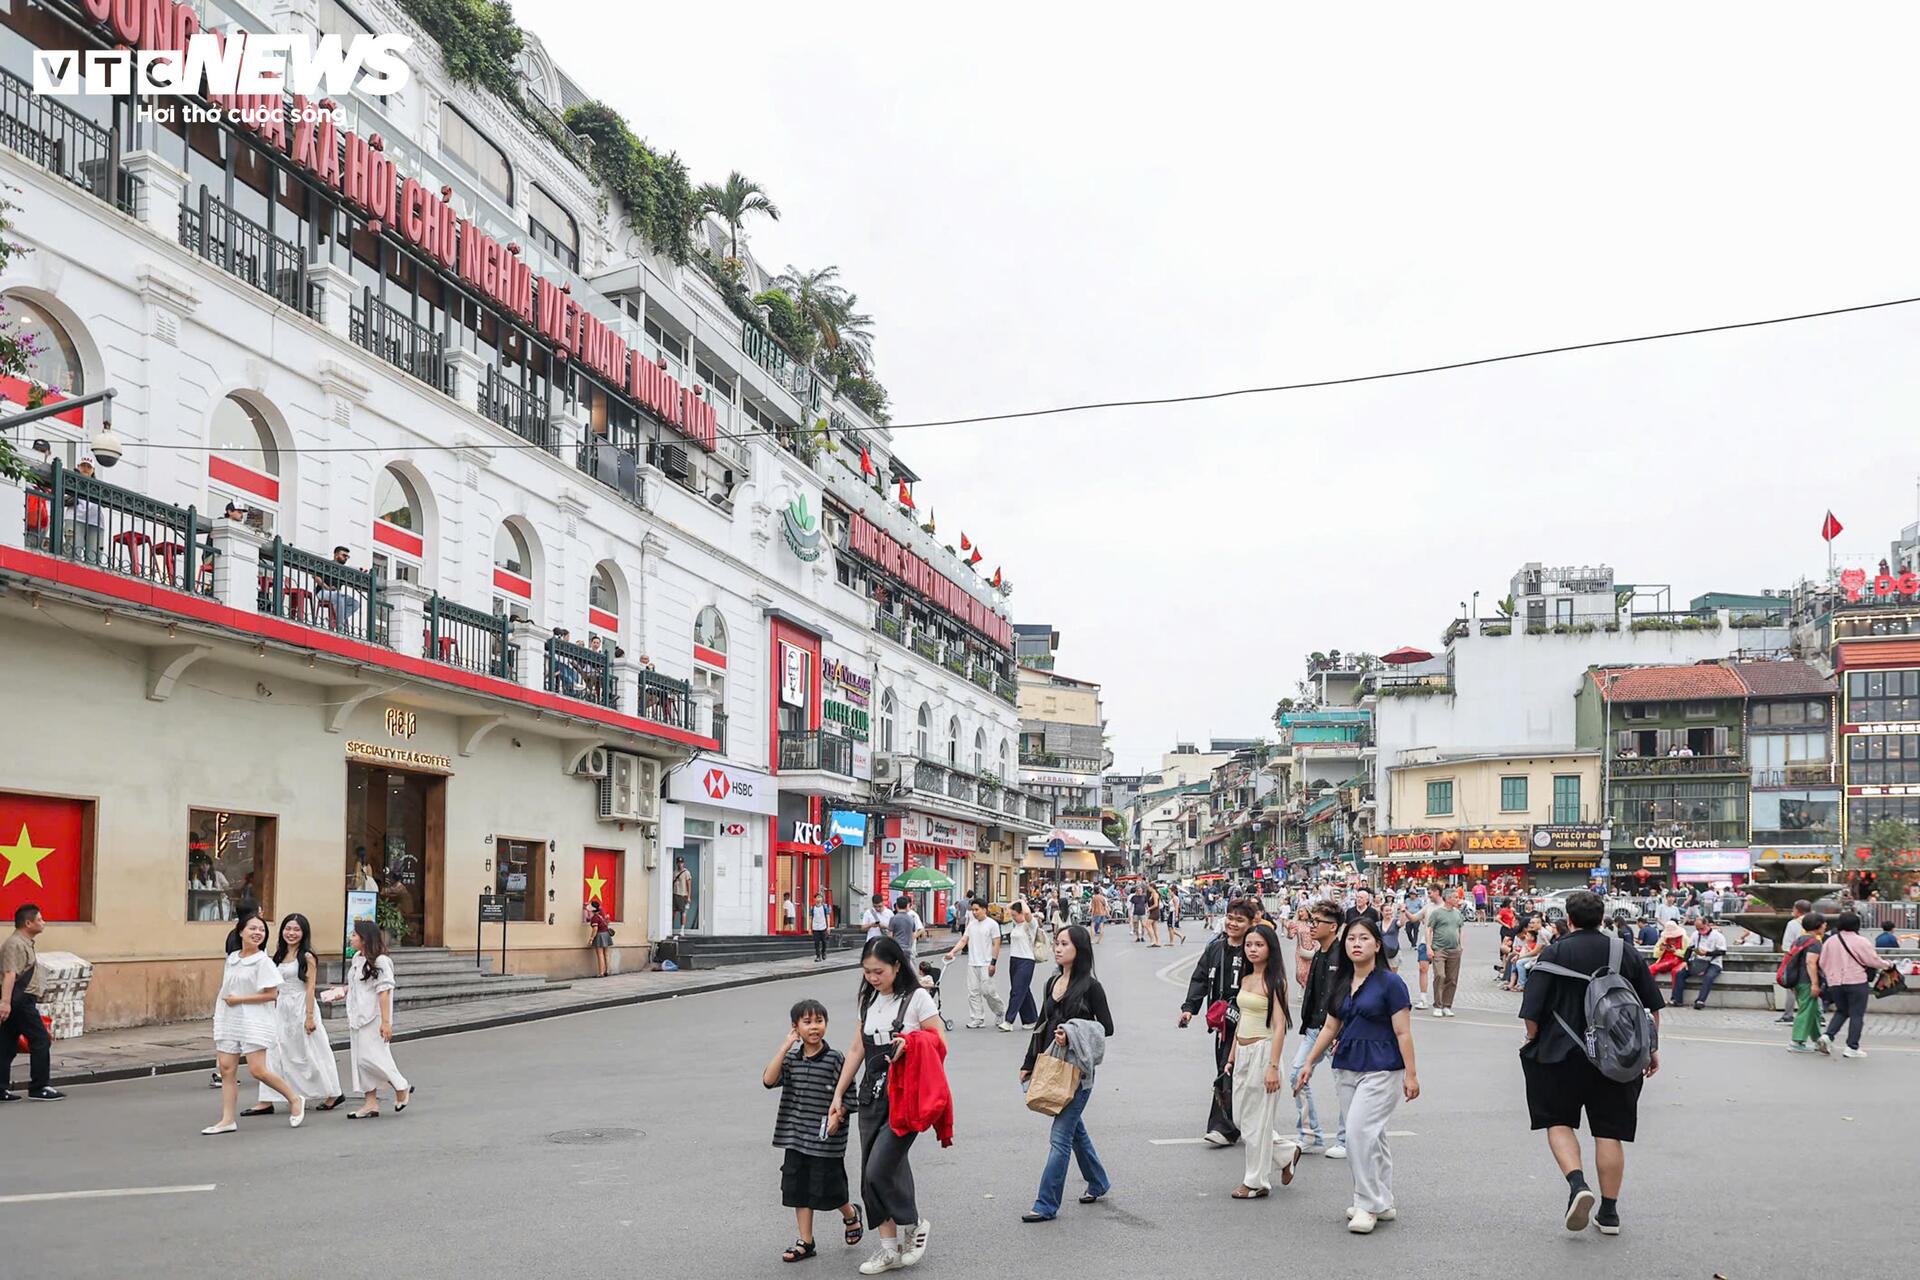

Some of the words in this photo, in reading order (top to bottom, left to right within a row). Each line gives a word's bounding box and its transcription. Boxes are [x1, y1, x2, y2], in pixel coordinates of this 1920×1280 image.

[344, 133, 396, 234] HỘI
[401, 177, 457, 270] CHỦ
[459, 219, 533, 325] NGHĨA
[537, 277, 583, 360] VIỆT
[582, 311, 627, 390] NAM
[630, 349, 681, 427] MUÔN
[681, 384, 718, 453] NĂM
[347, 741, 396, 759] SPECIALTY
[397, 750, 413, 762] TEA
[413, 752, 421, 763] &
[420, 754, 452, 768] COFFEE
[732, 781, 753, 798] HSBC
[793, 821, 822, 846] KFC
[1468, 837, 1527, 849] BAGEL
